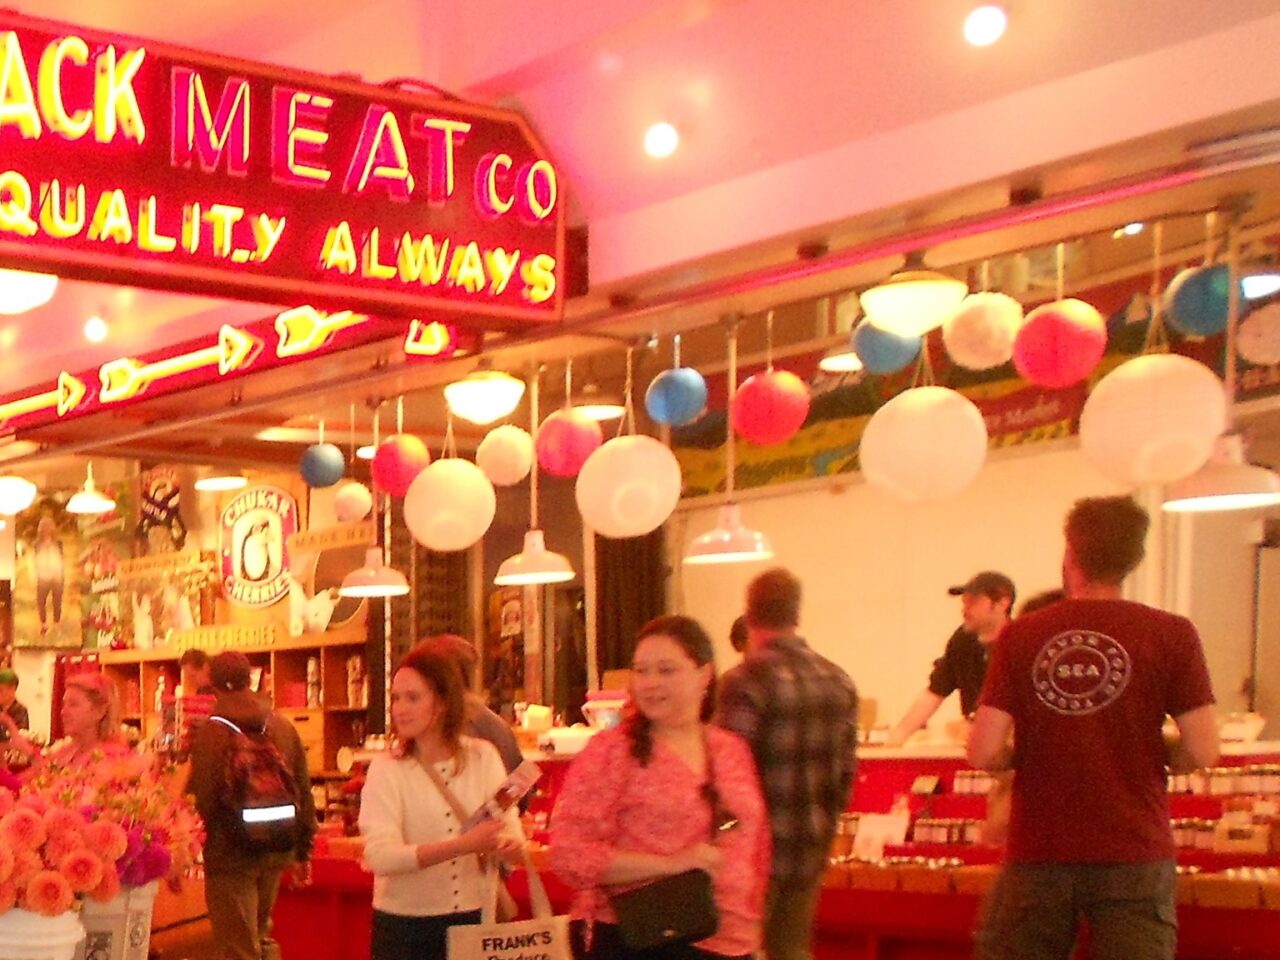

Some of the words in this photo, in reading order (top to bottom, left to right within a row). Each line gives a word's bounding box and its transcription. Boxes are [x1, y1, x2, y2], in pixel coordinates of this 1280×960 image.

[171, 66, 471, 206] MEAT
[475, 151, 558, 224] CO
[320, 222, 556, 303] ALWAYS
[224, 490, 291, 526] CHUKAR
[1056, 663, 1099, 678] SEA
[482, 930, 552, 951] FRANK'S
